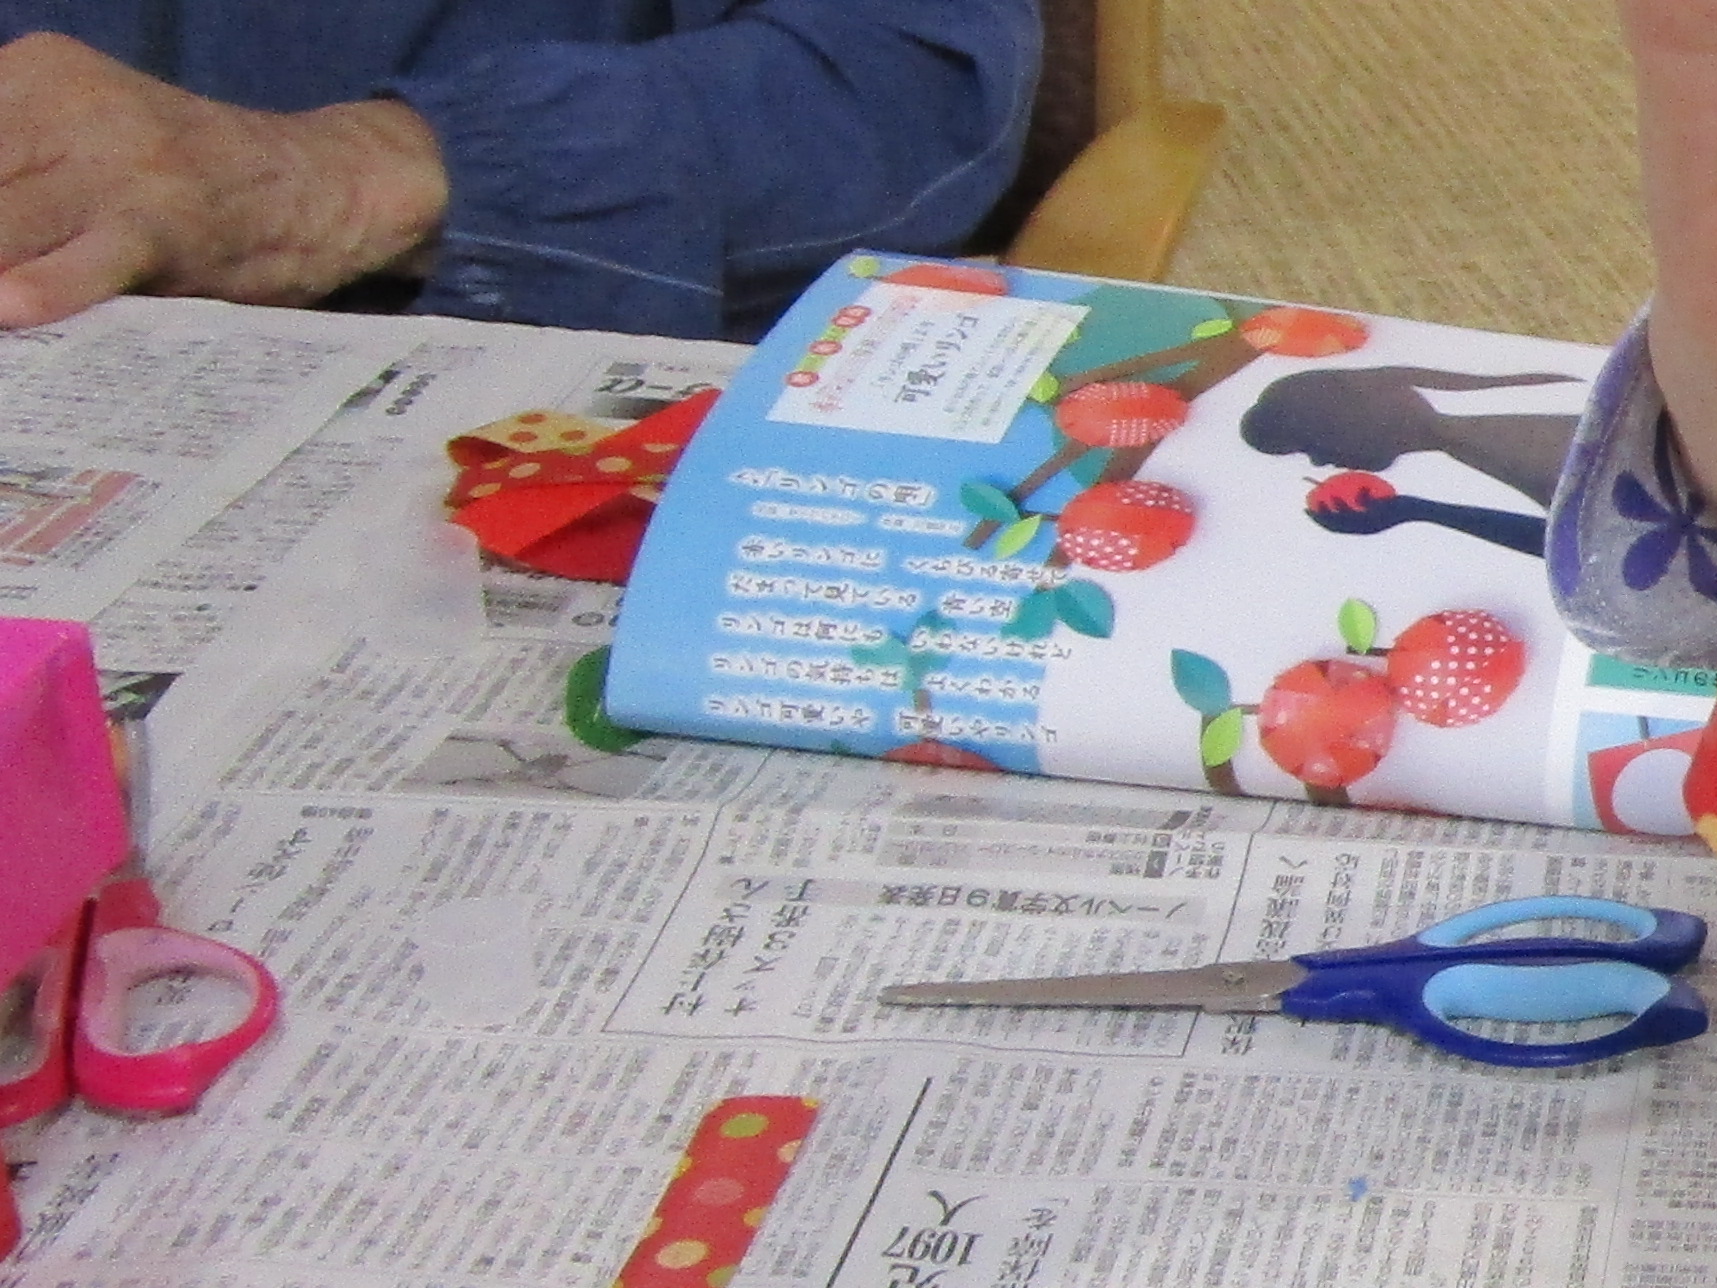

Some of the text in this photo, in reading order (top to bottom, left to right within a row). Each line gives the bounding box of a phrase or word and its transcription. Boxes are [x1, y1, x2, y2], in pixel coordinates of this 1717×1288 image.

[895, 314, 979, 403] 可愛いリンゴ
[742, 539, 1070, 586] 赤いリンゴに くちびる寄せて
[731, 573, 1016, 620] だまって見ている 青い空
[722, 616, 1073, 661] リンゴは何にも いわないけれど
[713, 656, 1041, 701] リンゴの気持ちは よくわかる
[708, 698, 1058, 744] リンゴ可愛いや 可愛いやリンゴ
[879, 882, 1189, 920] ノーベル文学賞9日発表
